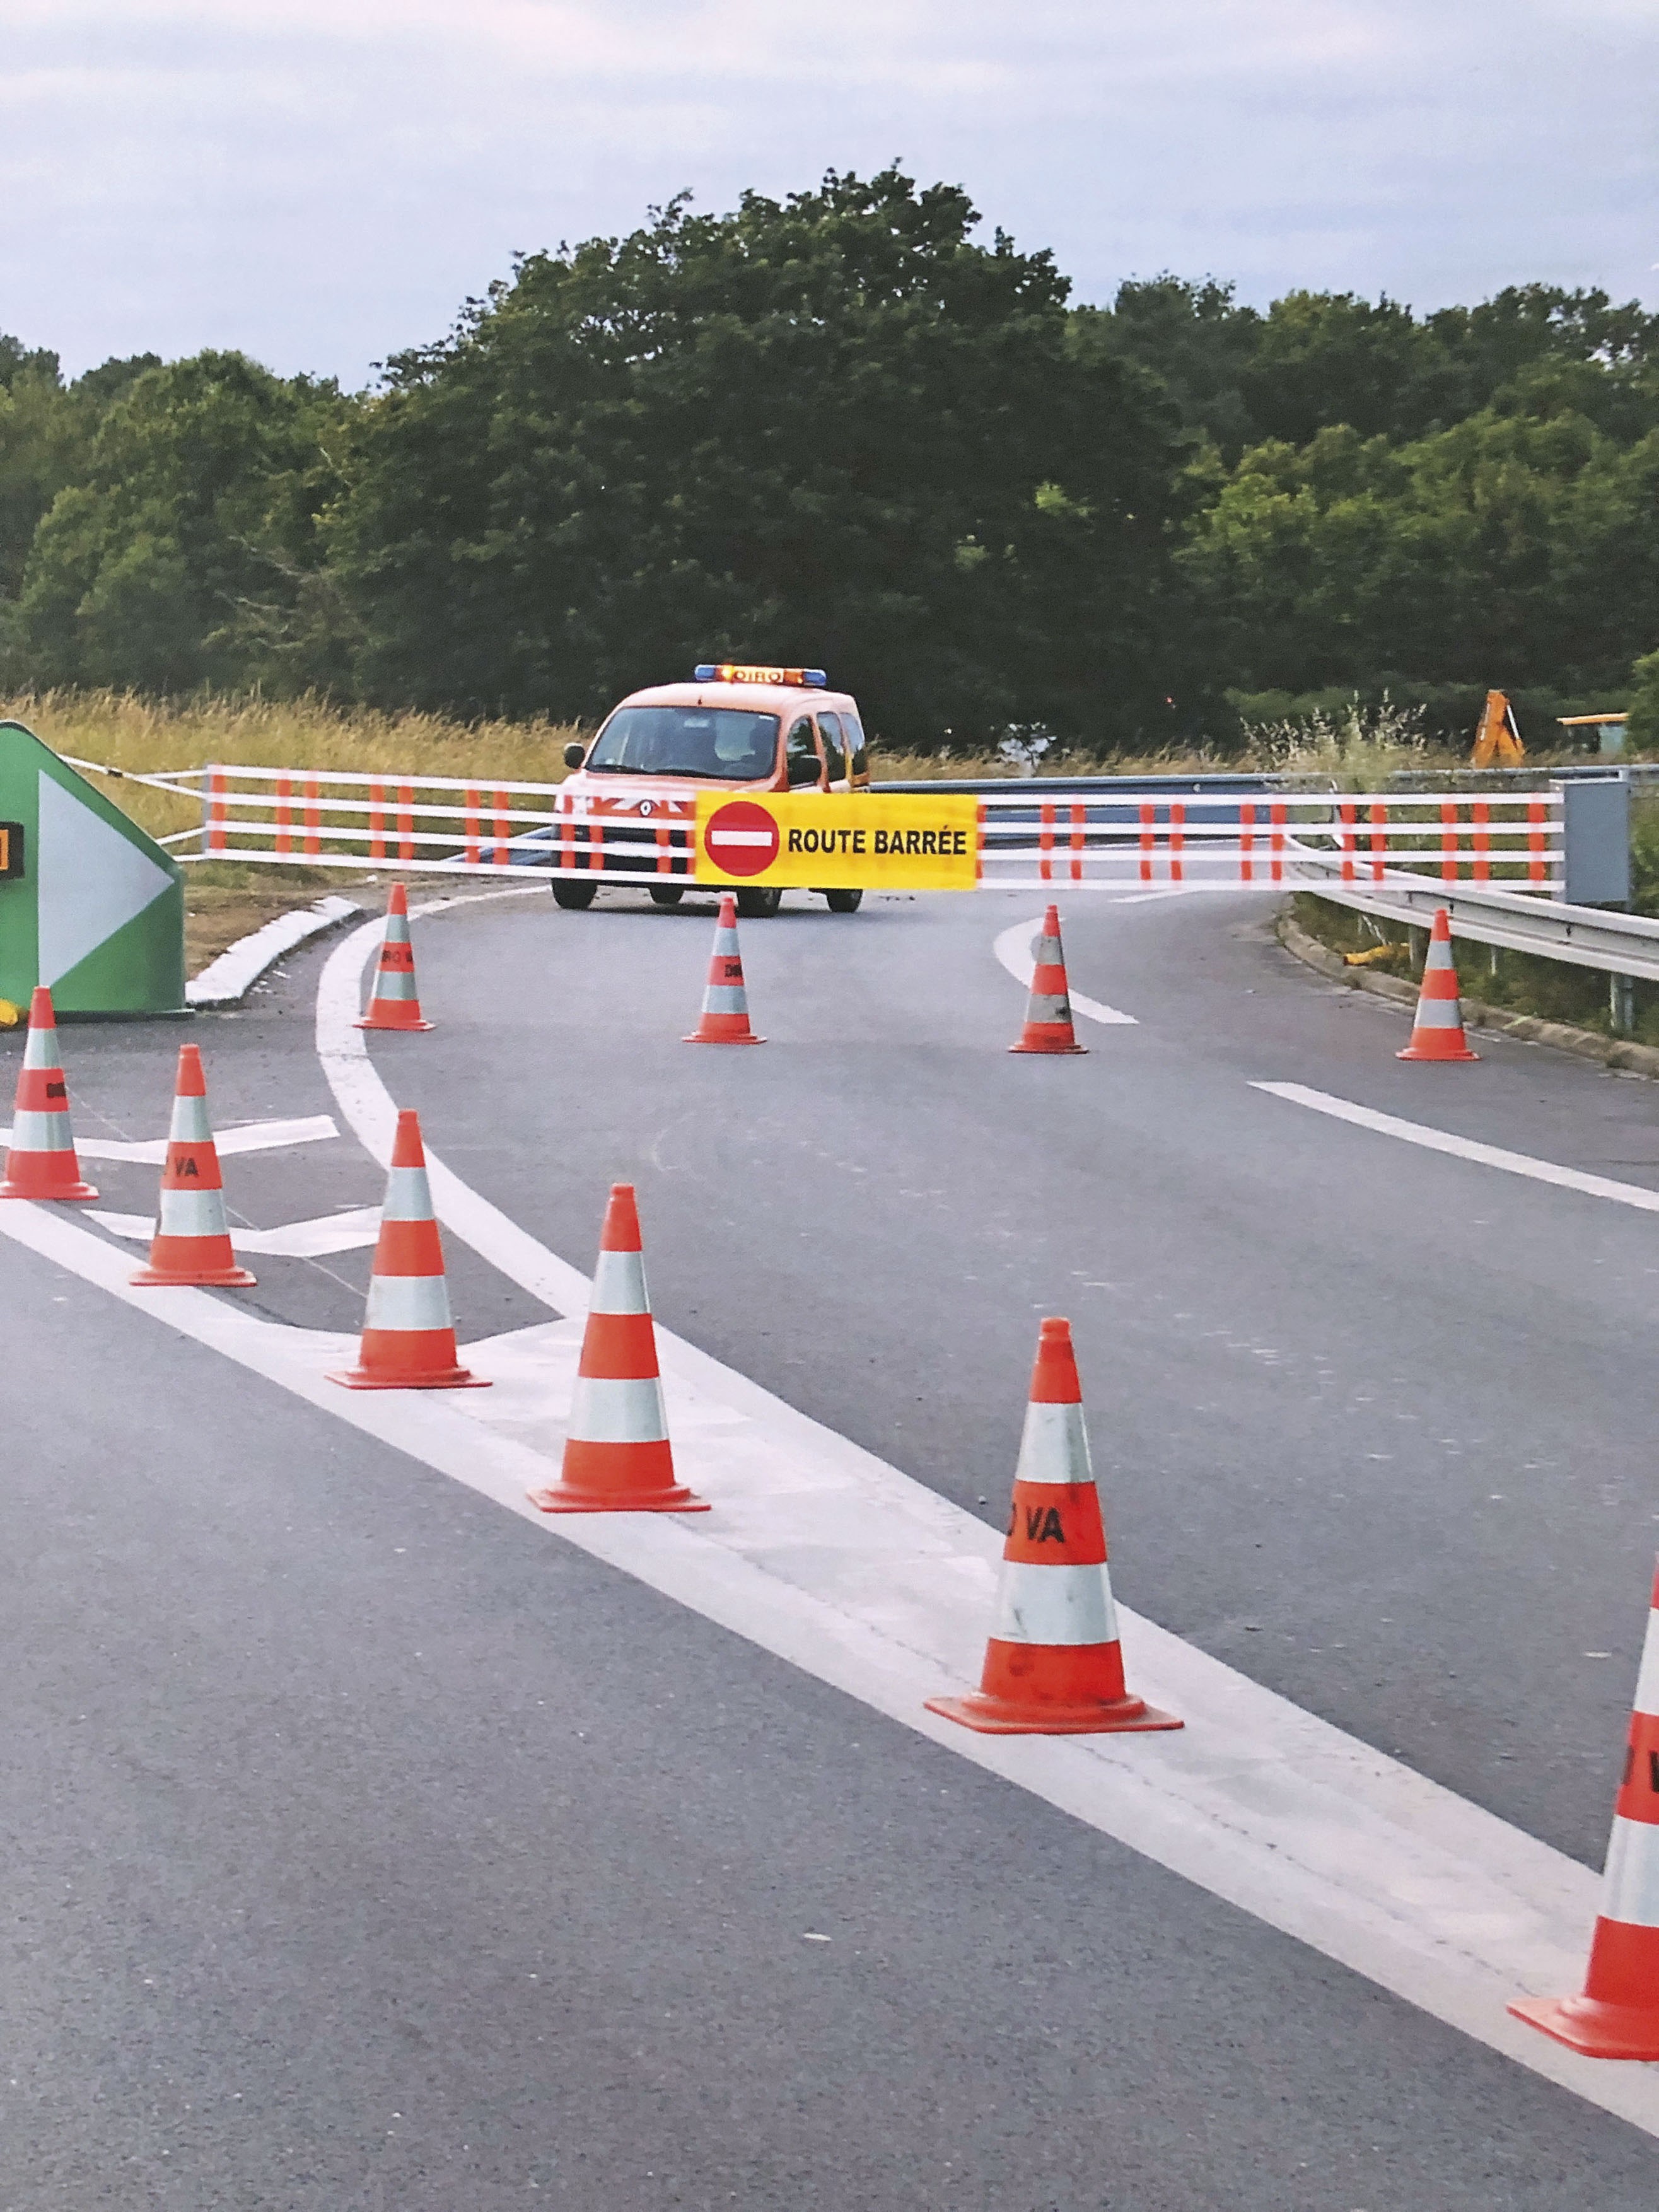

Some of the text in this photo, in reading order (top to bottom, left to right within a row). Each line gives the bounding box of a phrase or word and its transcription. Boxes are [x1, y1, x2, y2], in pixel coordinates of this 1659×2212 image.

[788, 824, 967, 854] ROUTE BARRÉE
[175, 1156, 199, 1177] VA
[1026, 1506, 1065, 1544] VA
